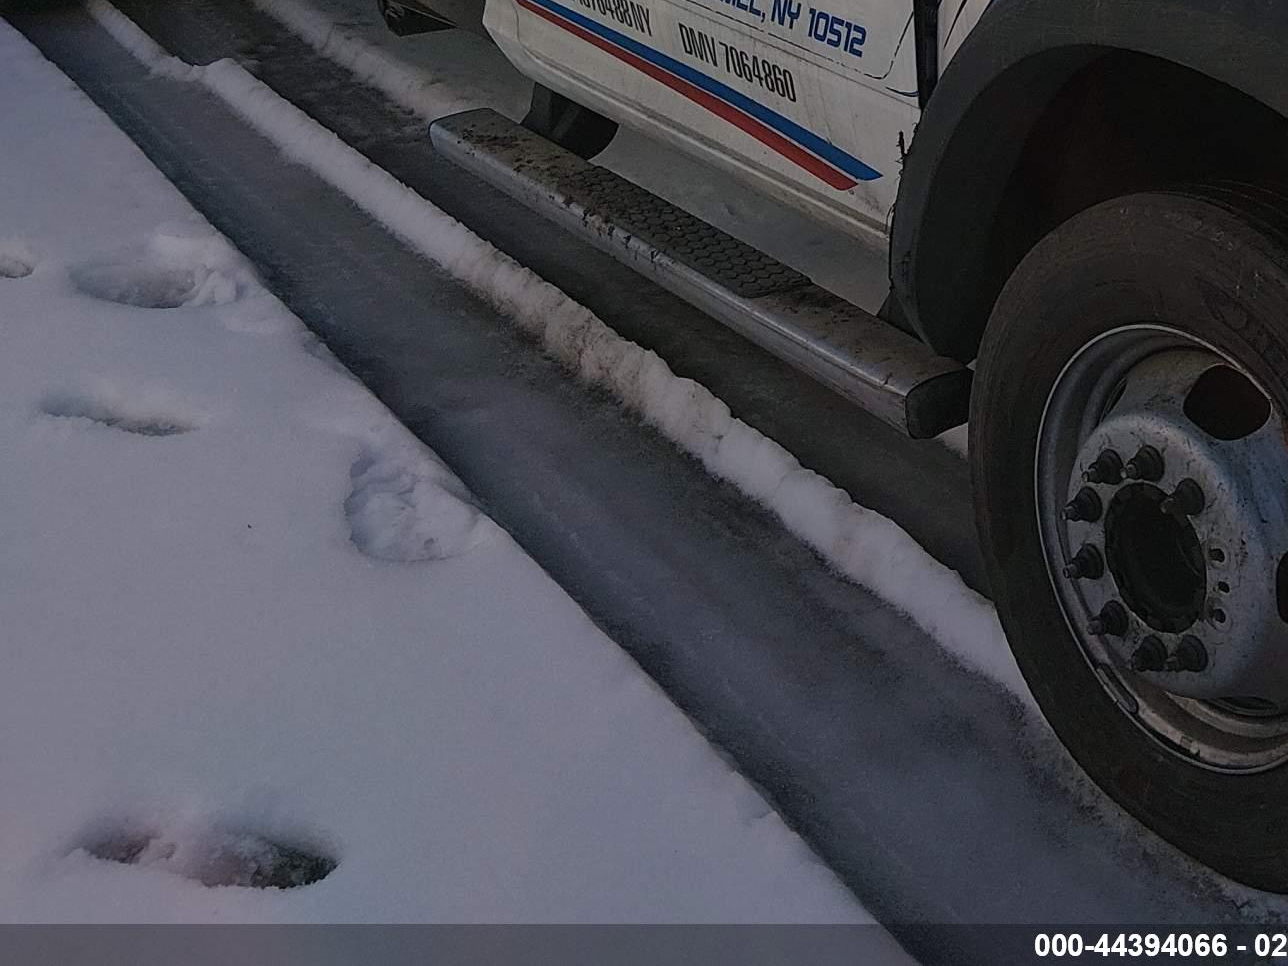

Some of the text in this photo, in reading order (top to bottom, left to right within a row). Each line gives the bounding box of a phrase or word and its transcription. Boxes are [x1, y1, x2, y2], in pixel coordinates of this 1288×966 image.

[678, 22, 797, 103] DMV 7064860
[808, 7, 867, 58] 10512
